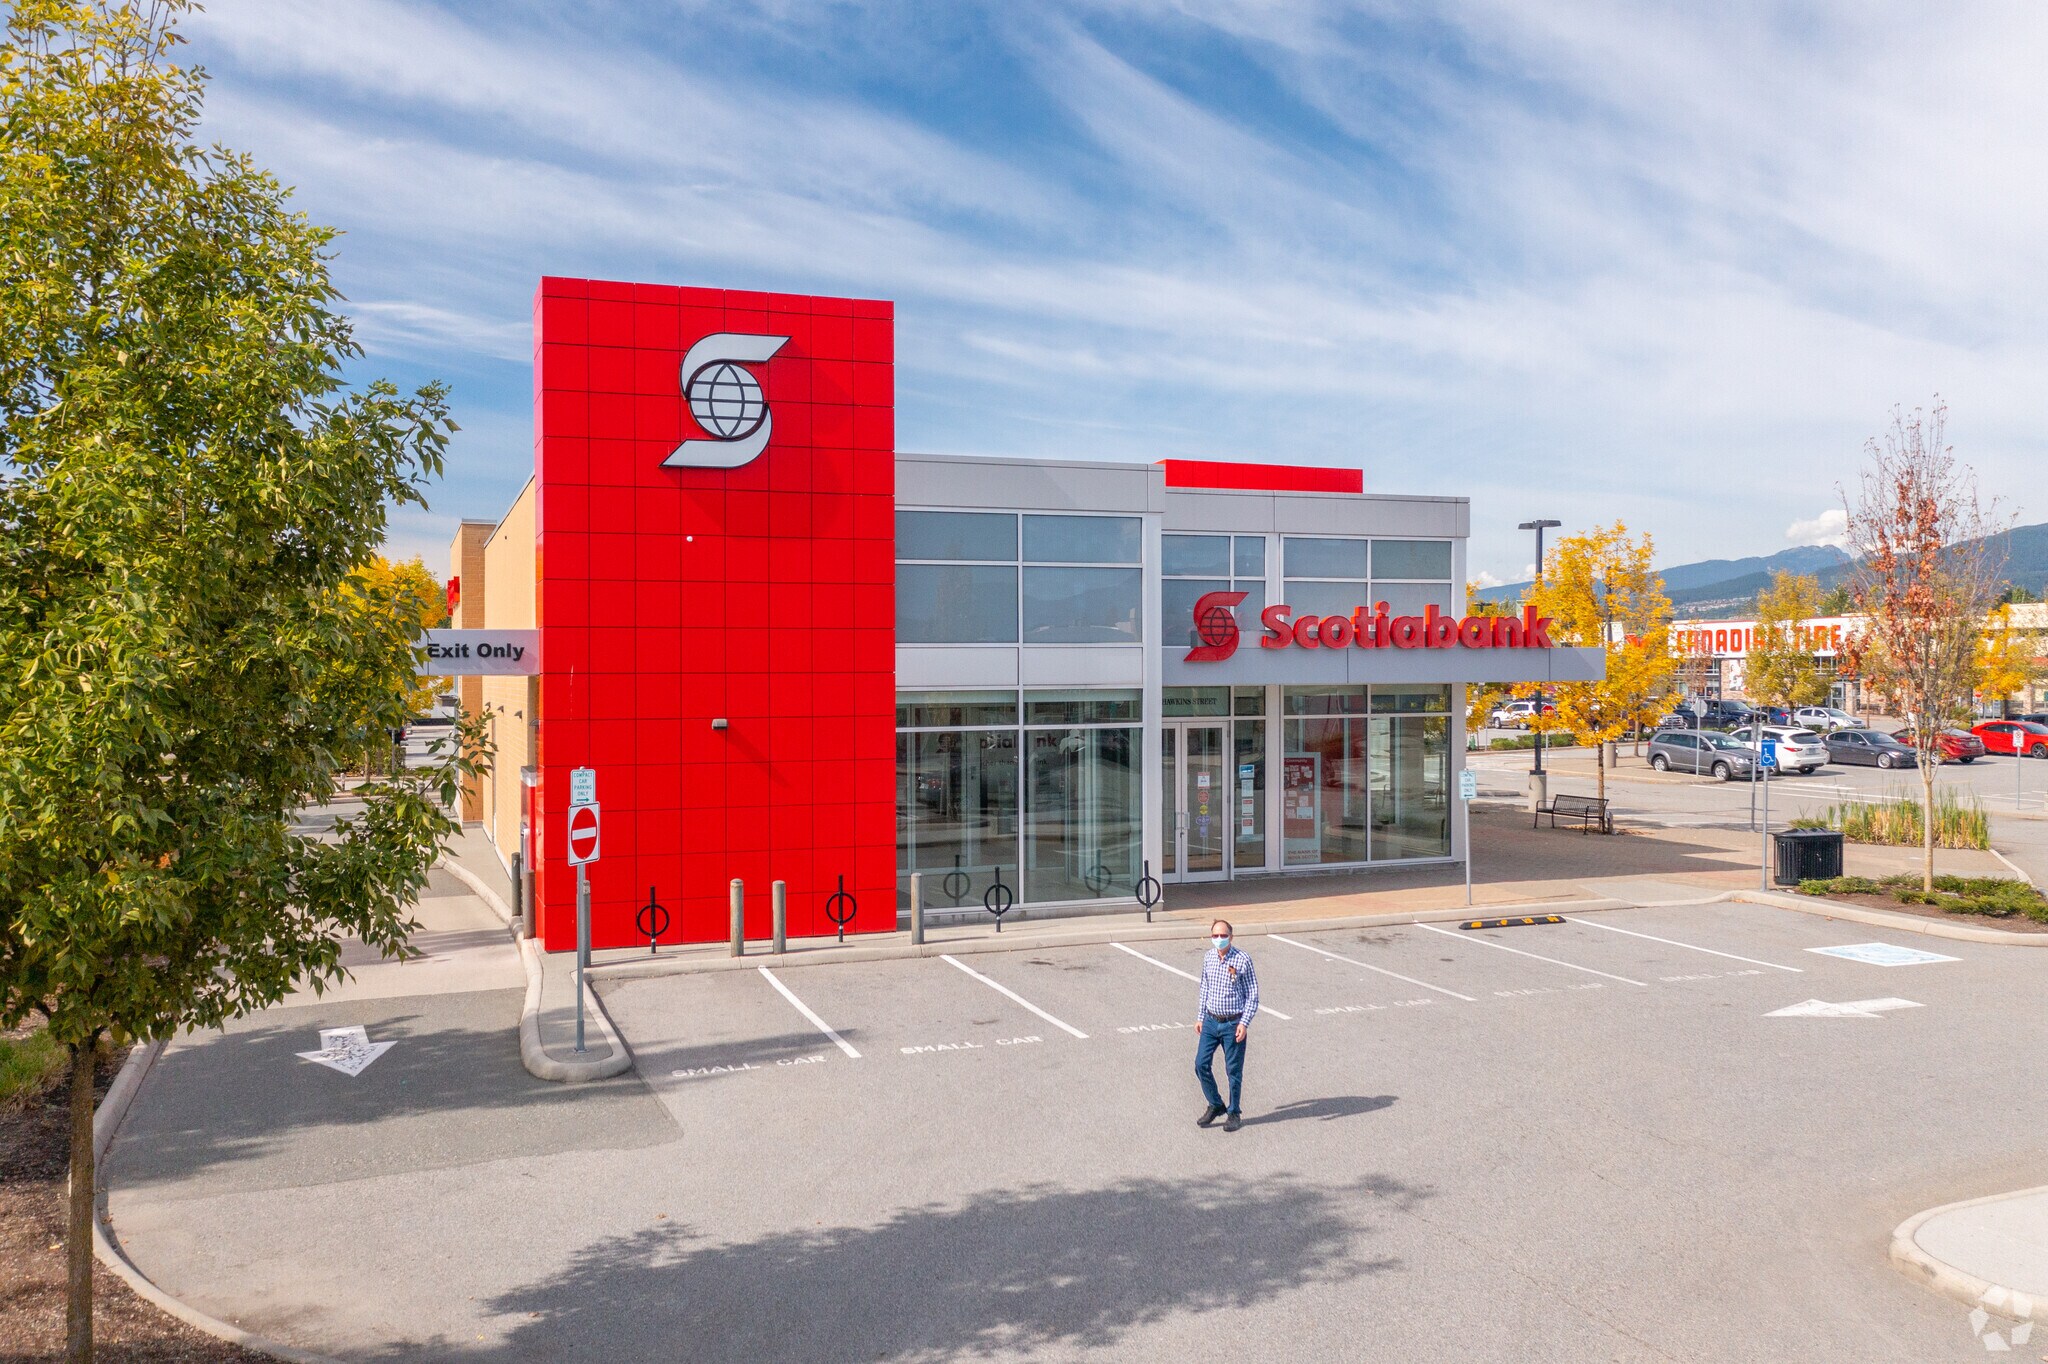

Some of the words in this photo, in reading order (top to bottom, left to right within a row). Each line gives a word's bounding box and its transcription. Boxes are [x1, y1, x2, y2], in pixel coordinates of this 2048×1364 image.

[1261, 600, 1554, 648] Scotiabank
[427, 643, 469, 658] Exit
[476, 643, 524, 661] Only
[1192, 697, 1217, 705] STREET
[1116, 1021, 1195, 1034] SMALL
[900, 1042, 983, 1054] SMALL
[996, 1035, 1043, 1046] CAR
[671, 1062, 761, 1077] SMALL
[776, 1055, 827, 1066] CAR
